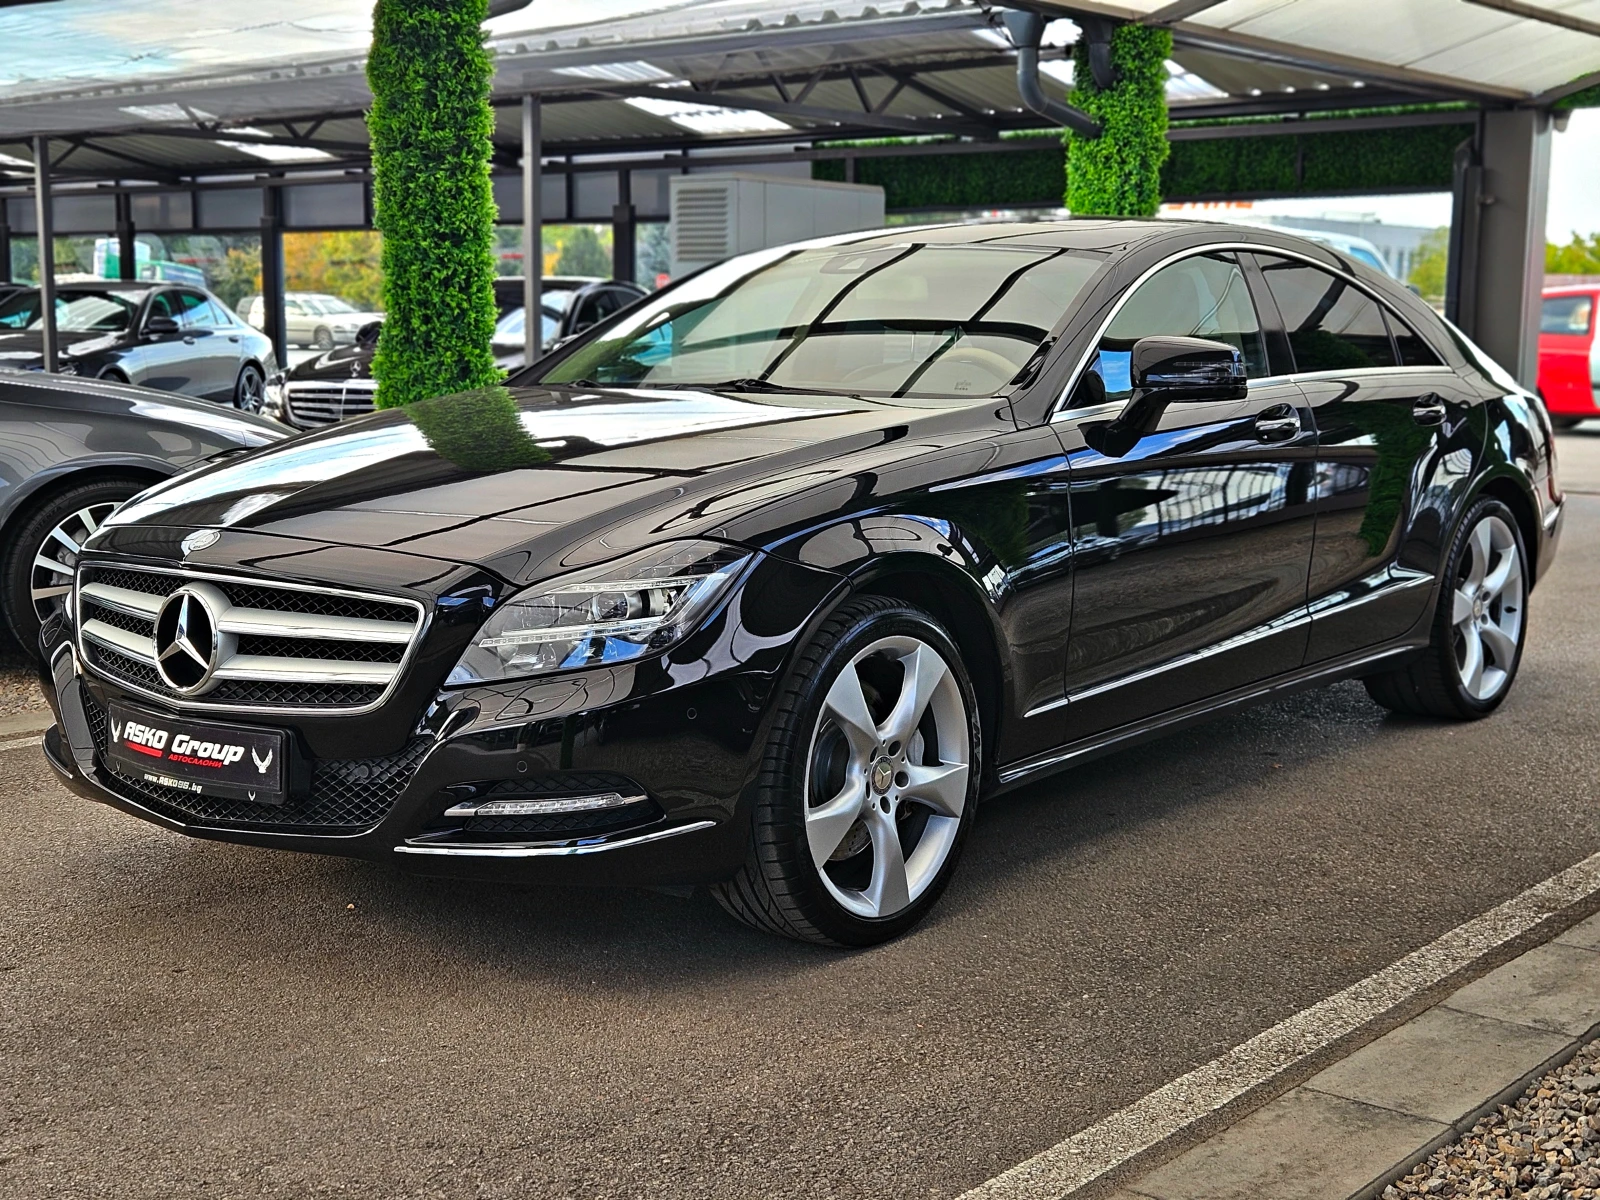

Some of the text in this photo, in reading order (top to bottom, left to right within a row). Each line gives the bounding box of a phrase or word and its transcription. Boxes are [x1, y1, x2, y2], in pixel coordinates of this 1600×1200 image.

[124, 721, 245, 766] ASKO Group
[168, 753, 223, 769] АВТОСАЛОНИ
